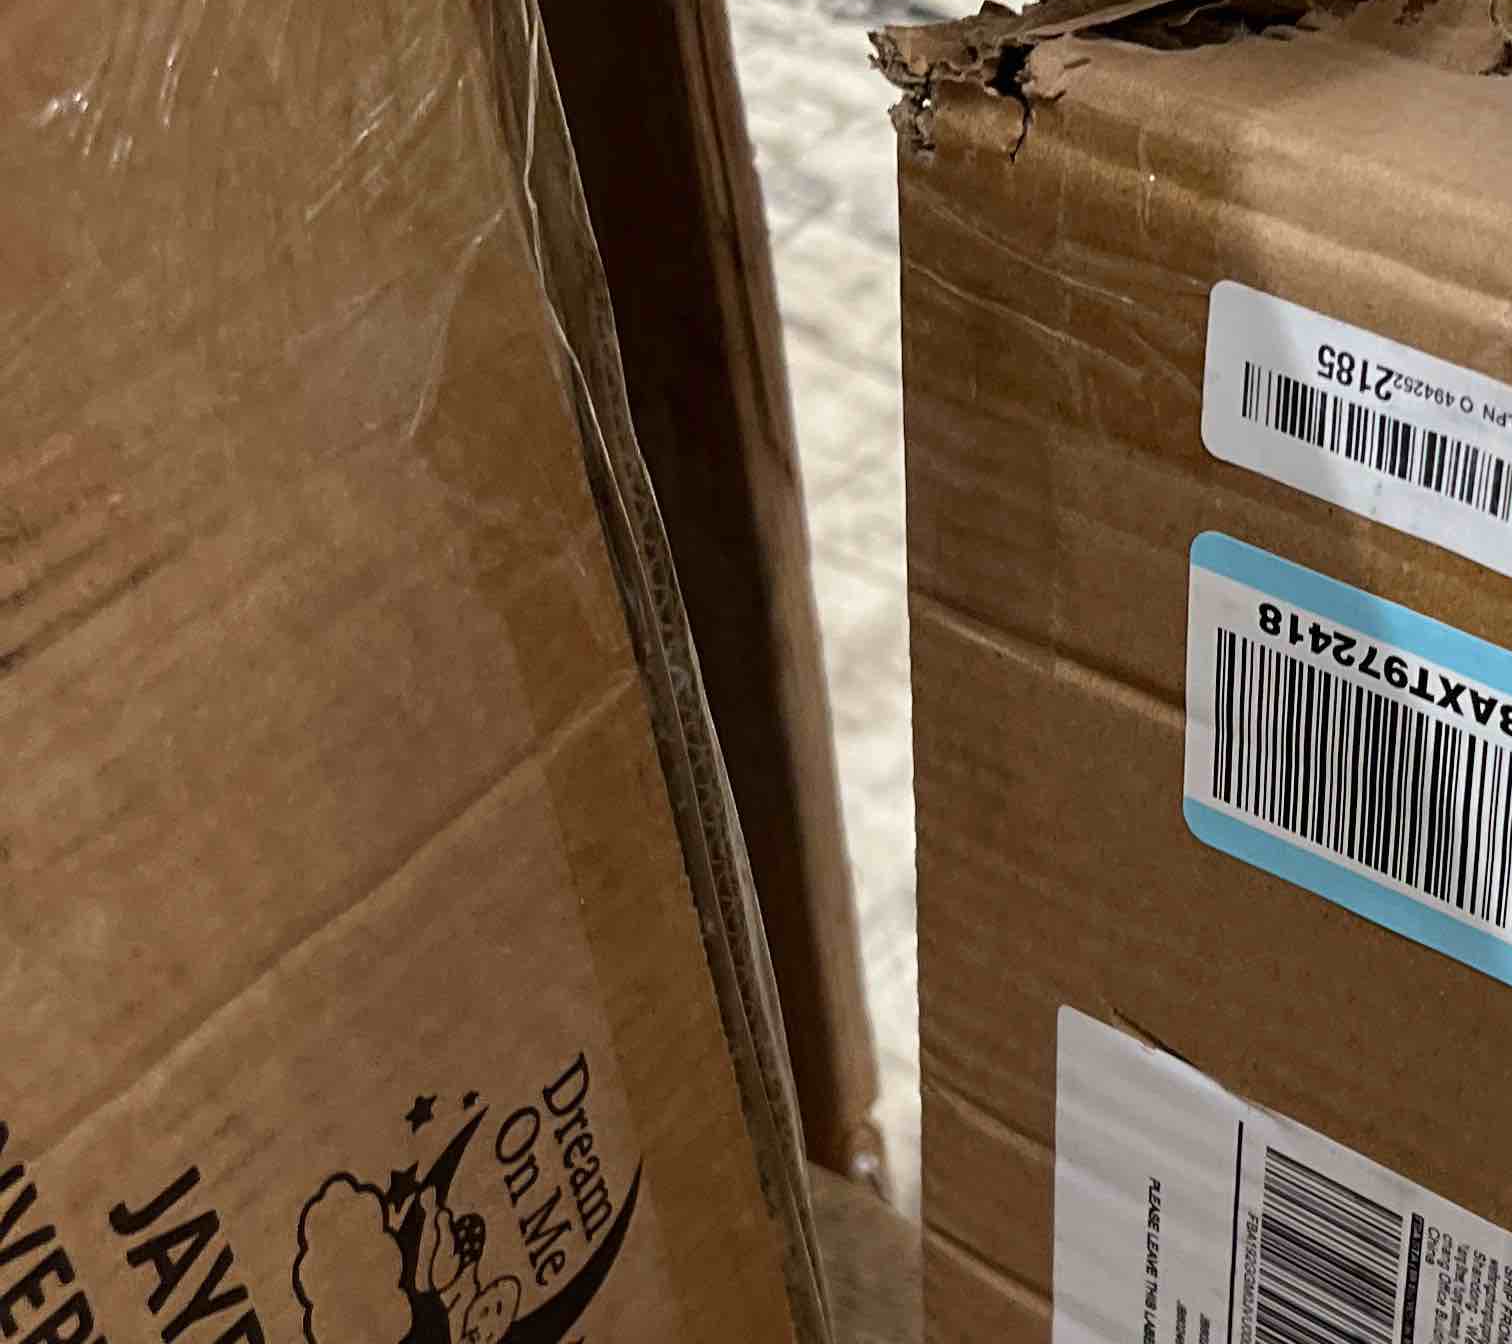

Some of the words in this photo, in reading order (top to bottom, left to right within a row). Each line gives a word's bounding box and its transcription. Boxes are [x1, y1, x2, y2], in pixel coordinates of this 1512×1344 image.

[494, 1105, 542, 1205] On
[518, 1186, 579, 1288] Me
[542, 1052, 615, 1241] Dream
[1147, 1176, 1161, 1233] PLEASE
[1145, 1231, 1159, 1279] LEAVE
